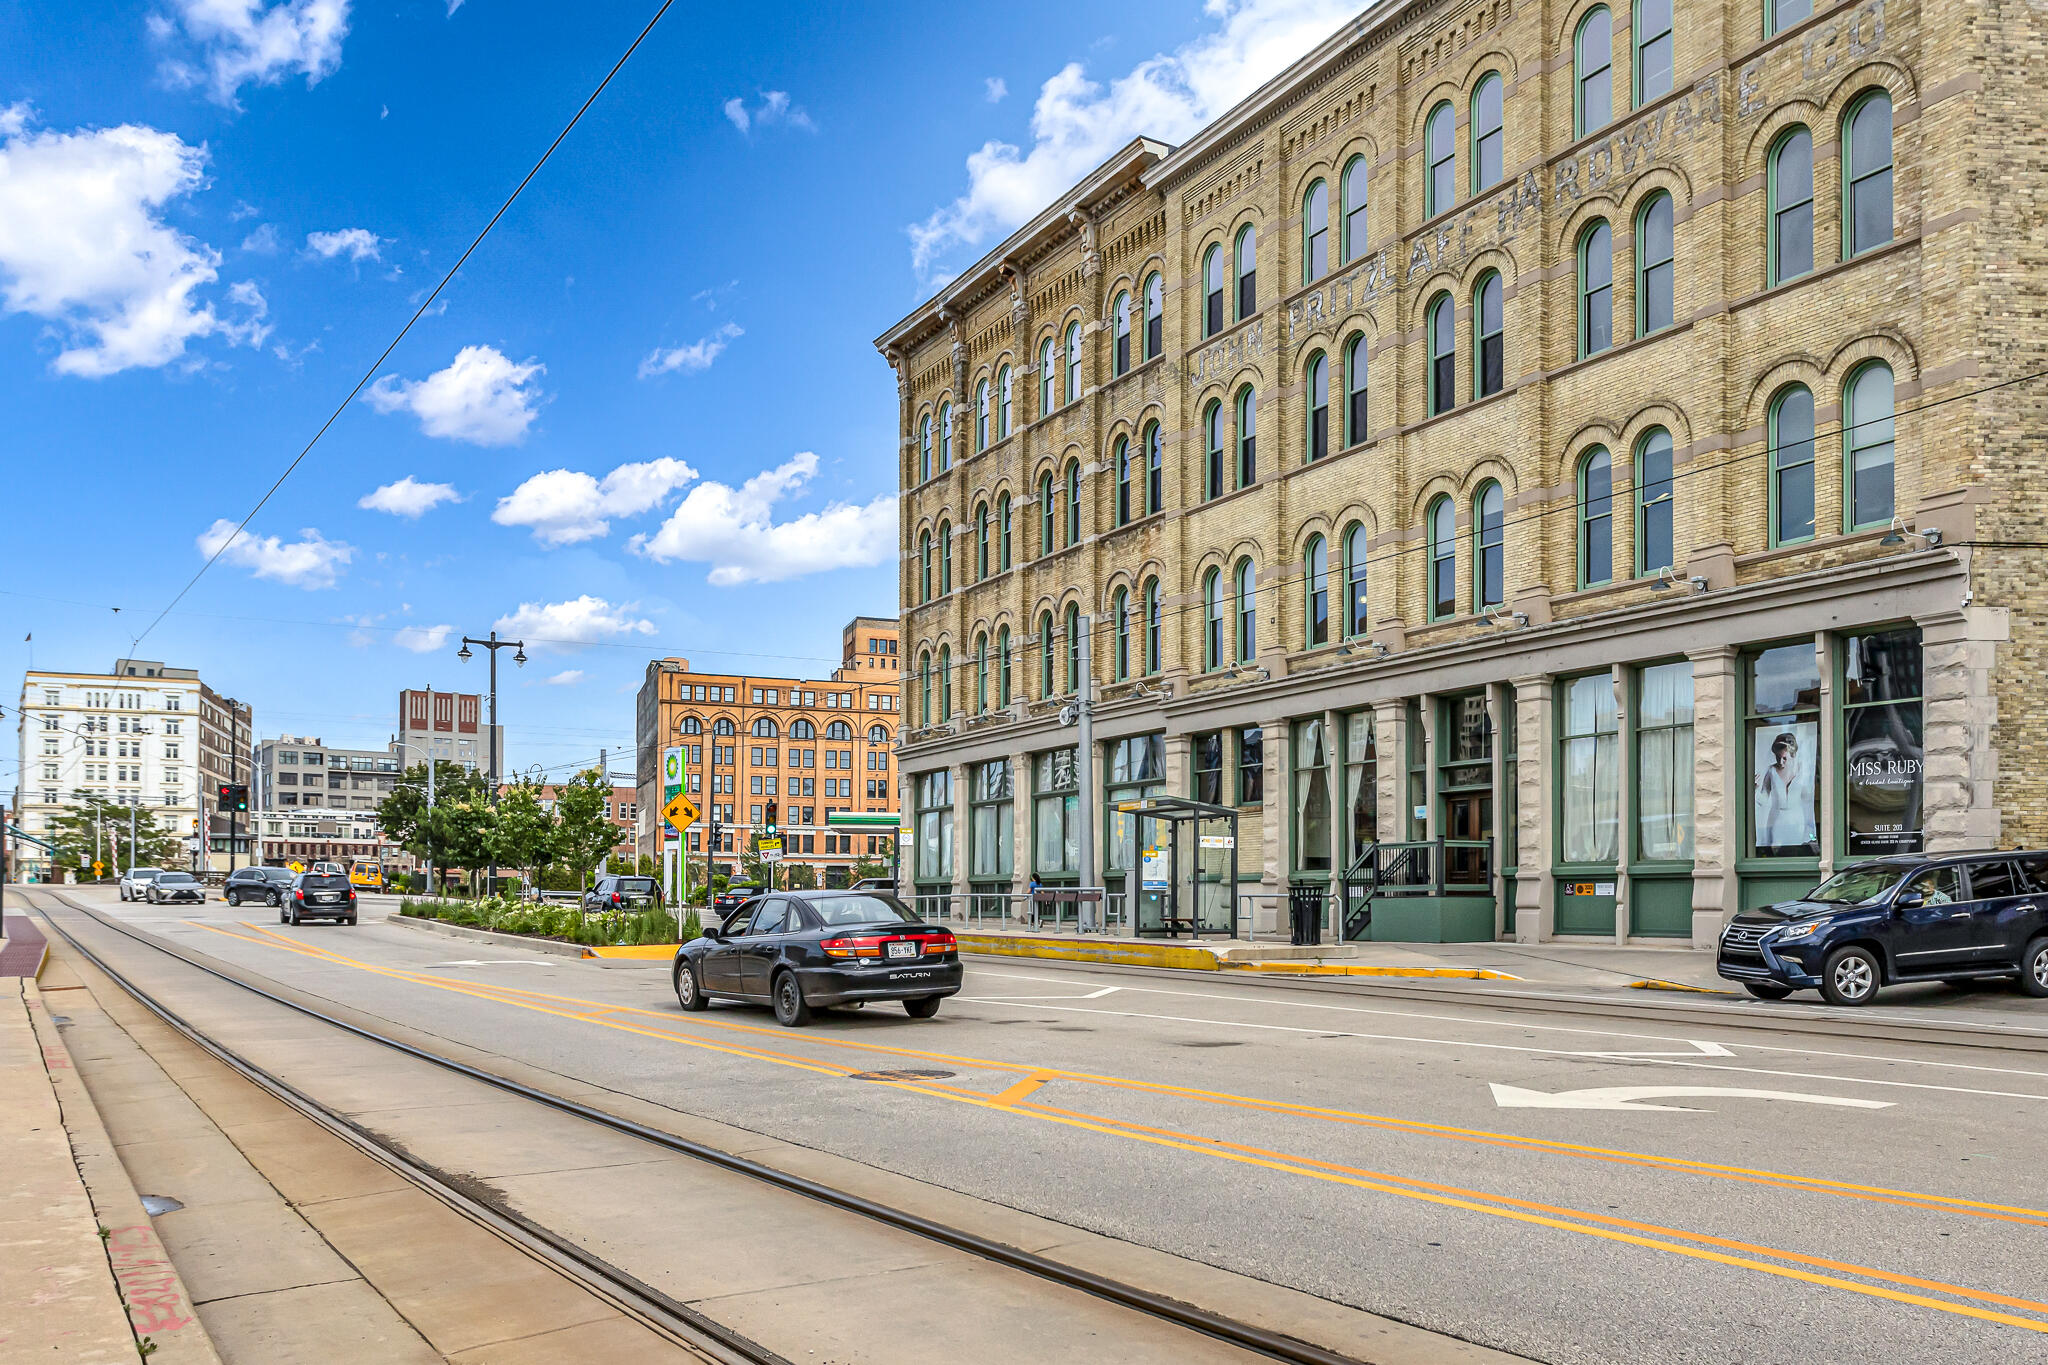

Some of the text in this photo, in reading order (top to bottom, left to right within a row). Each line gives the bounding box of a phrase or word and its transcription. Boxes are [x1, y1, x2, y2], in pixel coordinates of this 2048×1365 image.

[1191, 320, 1264, 387] JOHN
[1850, 760, 1924, 776] MISS RUBY
[1865, 778, 1886, 786] bridal
[1887, 778, 1914, 787] boutique
[1874, 824, 1891, 832] SUITE
[889, 972, 931, 980] SATURN
